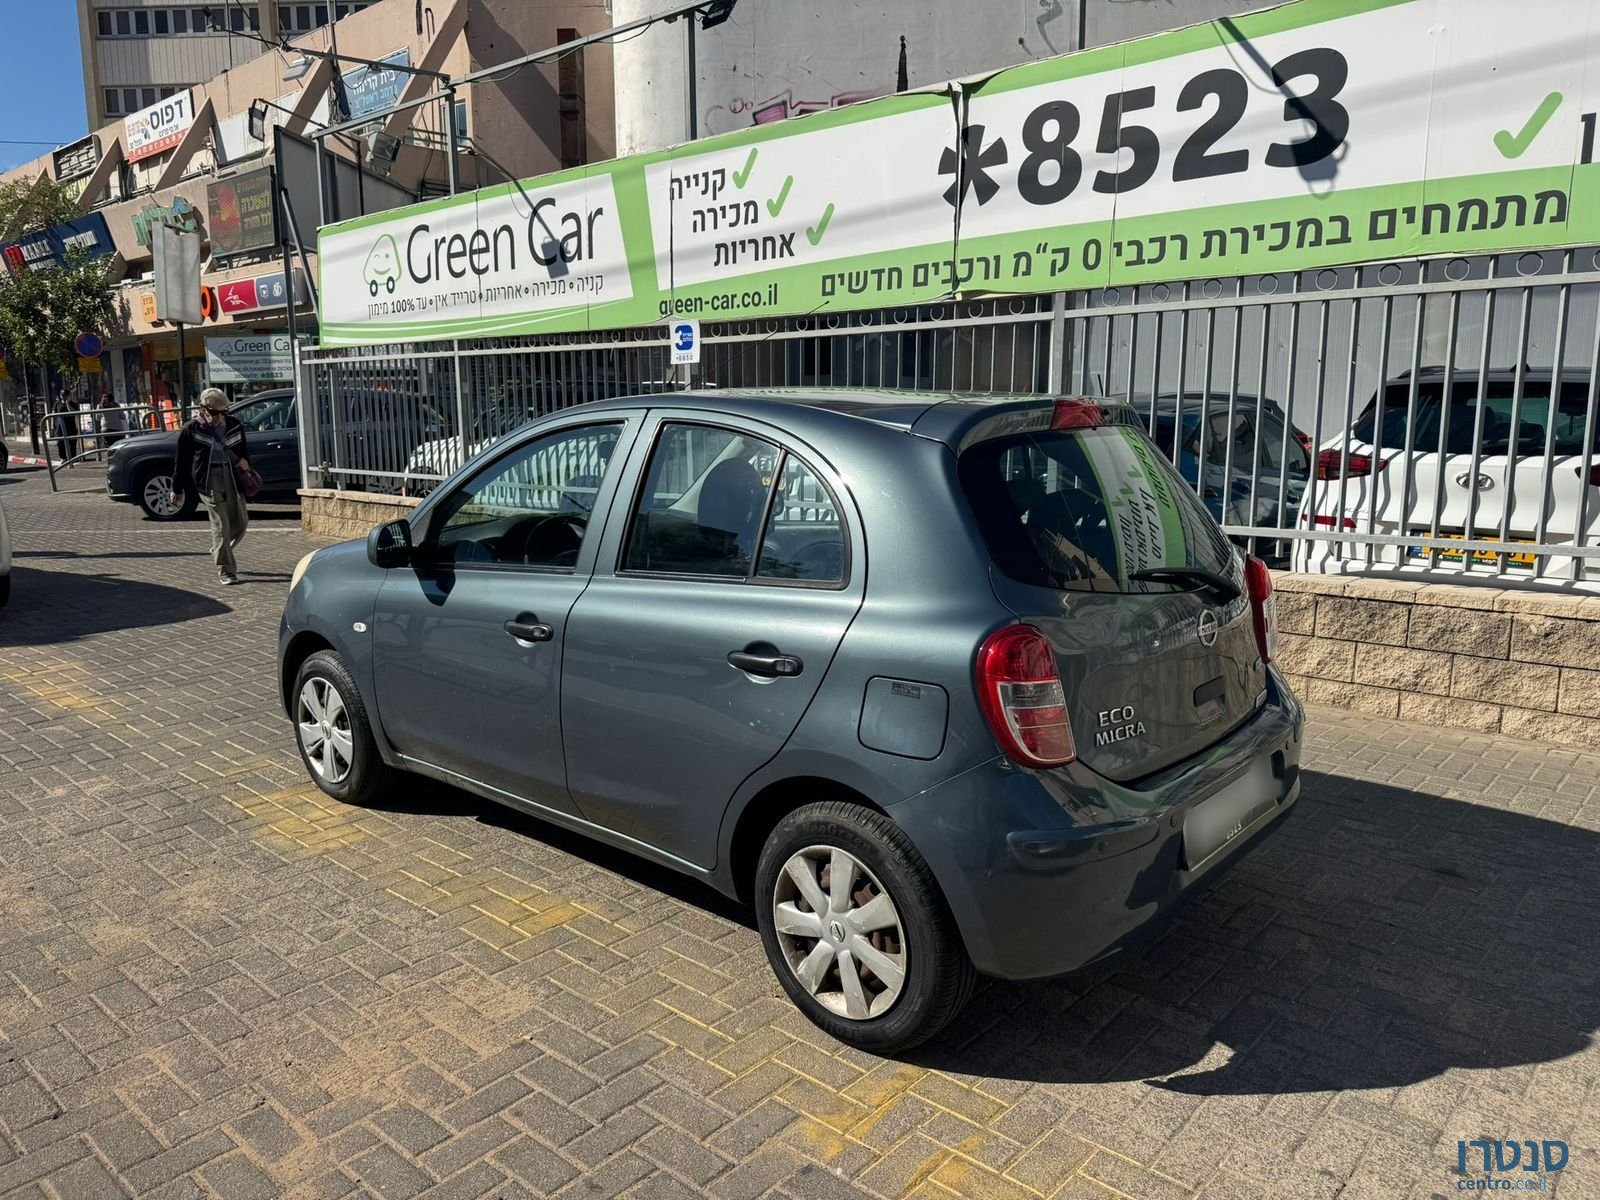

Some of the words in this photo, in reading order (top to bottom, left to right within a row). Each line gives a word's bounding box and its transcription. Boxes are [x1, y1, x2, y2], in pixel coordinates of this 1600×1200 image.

[149, 98, 184, 130] דפוס
[669, 168, 726, 201] קנייה
[692, 200, 759, 233] מכירה
[1367, 188, 1567, 242] מתמחים
[406, 223, 516, 284] Green
[528, 197, 604, 267] Car
[713, 232, 796, 267] אחריות
[1113, 233, 1188, 267] רכבי
[1199, 214, 1352, 259] במכירת
[1082, 238, 1101, 271] 0
[576, 275, 603, 296] קניה
[820, 265, 903, 297] חדשים
[912, 254, 1001, 288] ורכבים
[434, 293, 448, 312] אין
[450, 290, 476, 306] טרייד
[485, 284, 522, 302] אחריות
[532, 279, 566, 297] מכירה
[367, 302, 389, 320] מימון
[391, 298, 415, 314] 100%
[416, 296, 427, 310] עד
[234, 339, 272, 353] Green
[274, 338, 290, 352] Ca
[1098, 705, 1135, 727] ECO
[1096, 721, 1146, 747] MICRA
